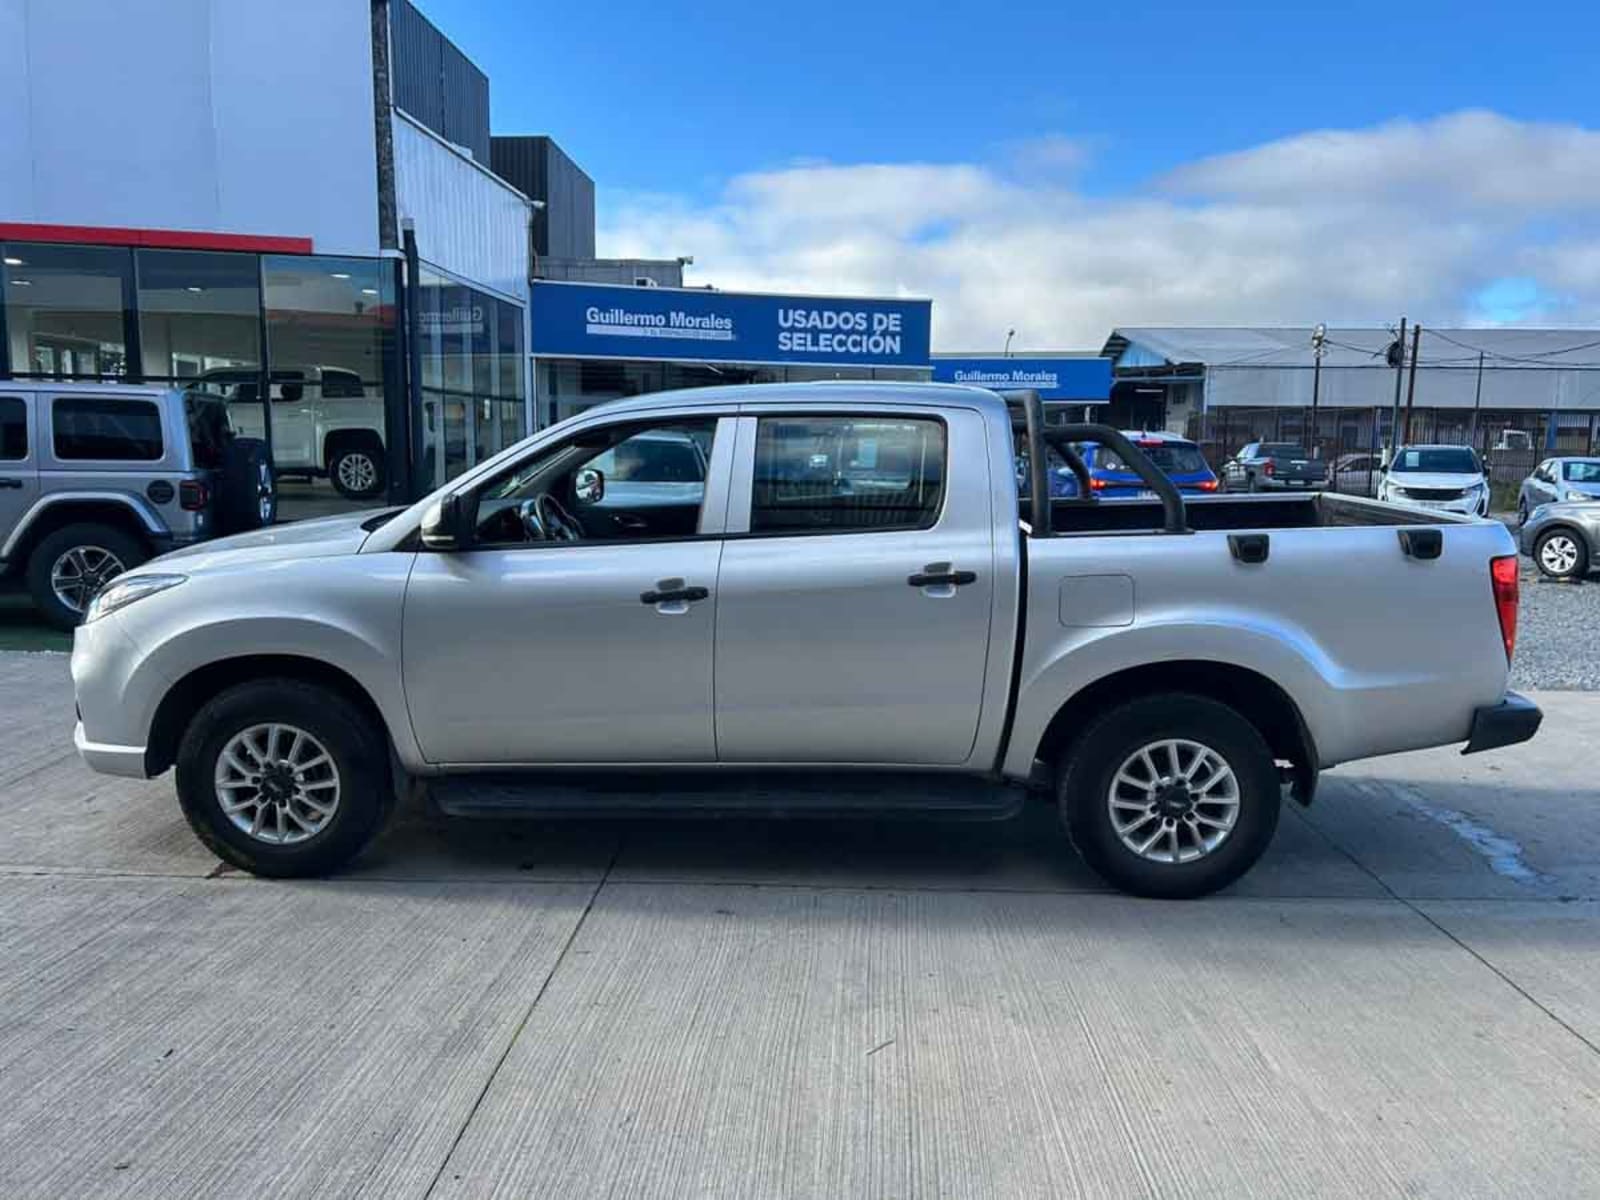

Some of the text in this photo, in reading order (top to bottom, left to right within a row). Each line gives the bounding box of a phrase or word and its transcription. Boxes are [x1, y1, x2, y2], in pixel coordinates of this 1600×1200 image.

[586, 307, 733, 329] Guillermo Morales
[778, 308, 902, 332] USADOS DE
[778, 329, 901, 354] SELECCIÓN
[954, 370, 1057, 382] Guillermo Morales
